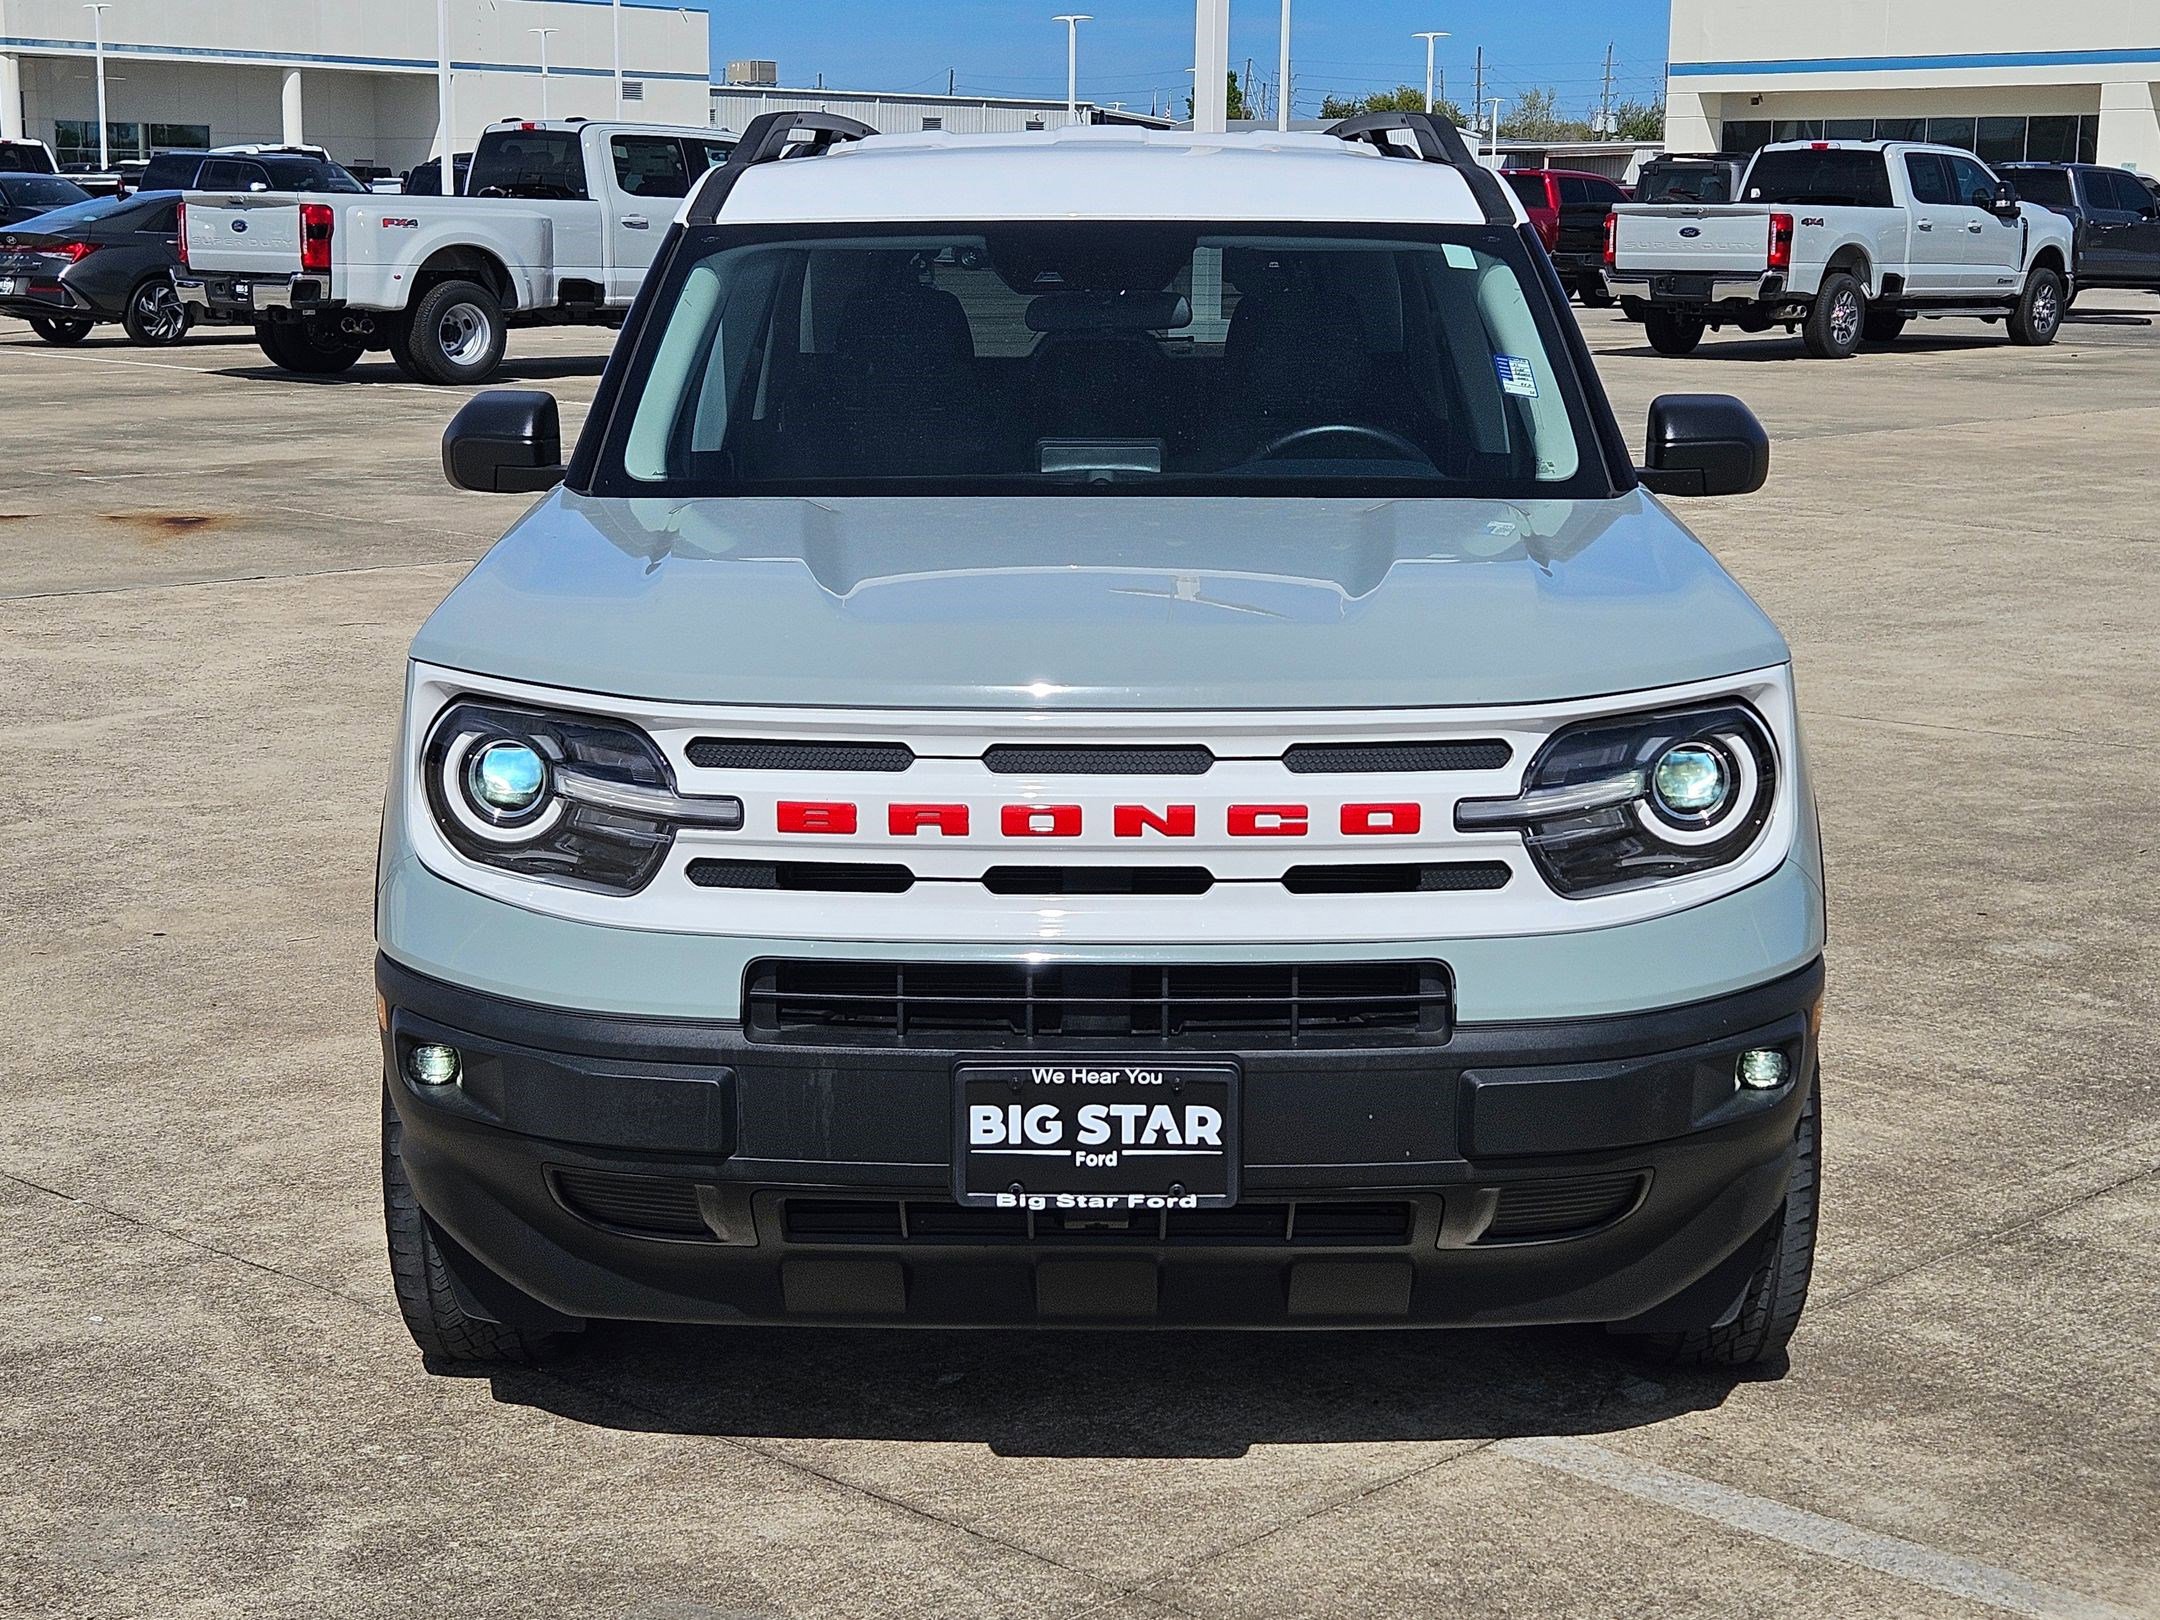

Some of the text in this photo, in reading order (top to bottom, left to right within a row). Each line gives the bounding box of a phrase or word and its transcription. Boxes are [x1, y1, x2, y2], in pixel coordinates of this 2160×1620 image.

[382, 218, 418, 227] FX4
[192, 236, 293, 248] SUPER DUTY
[1624, 240, 1759, 250] SUPER DUTY
[777, 801, 1421, 837] BRONCO
[1032, 1069, 1163, 1085] We Hear You
[969, 1104, 1222, 1145] BIG STAR
[1075, 1151, 1118, 1167] Ford
[996, 1194, 1197, 1210] Big Star Ford
